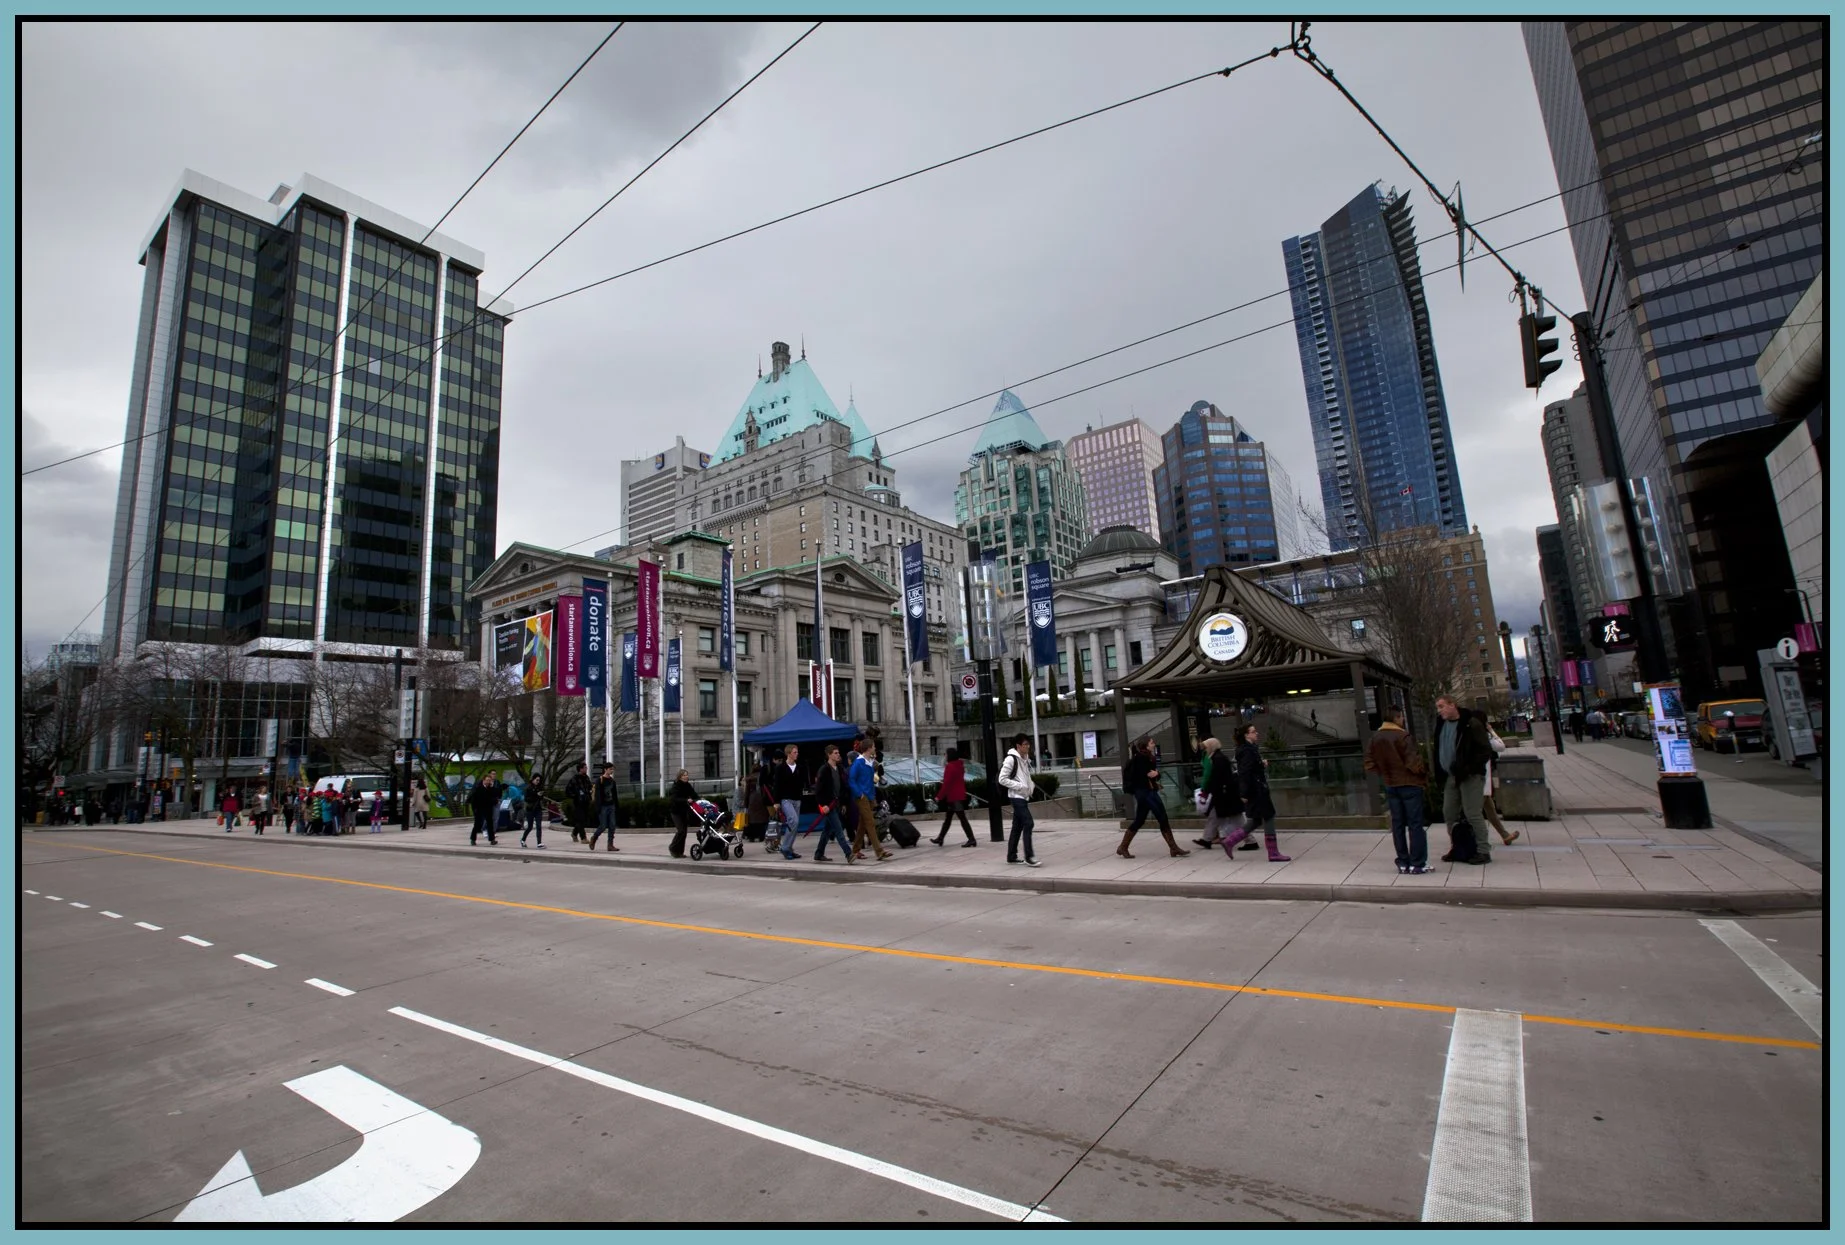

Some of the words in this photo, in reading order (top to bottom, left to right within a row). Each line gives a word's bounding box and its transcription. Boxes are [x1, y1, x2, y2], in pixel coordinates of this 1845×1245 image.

[905, 560, 922, 569] robson
[905, 566, 922, 576] square
[1030, 577, 1050, 585] robson
[1031, 583, 1050, 591] square
[589, 596, 603, 652] donate
[568, 603, 576, 672] startanevolution.ca
[1207, 640, 1240, 649] COLUMBIA
